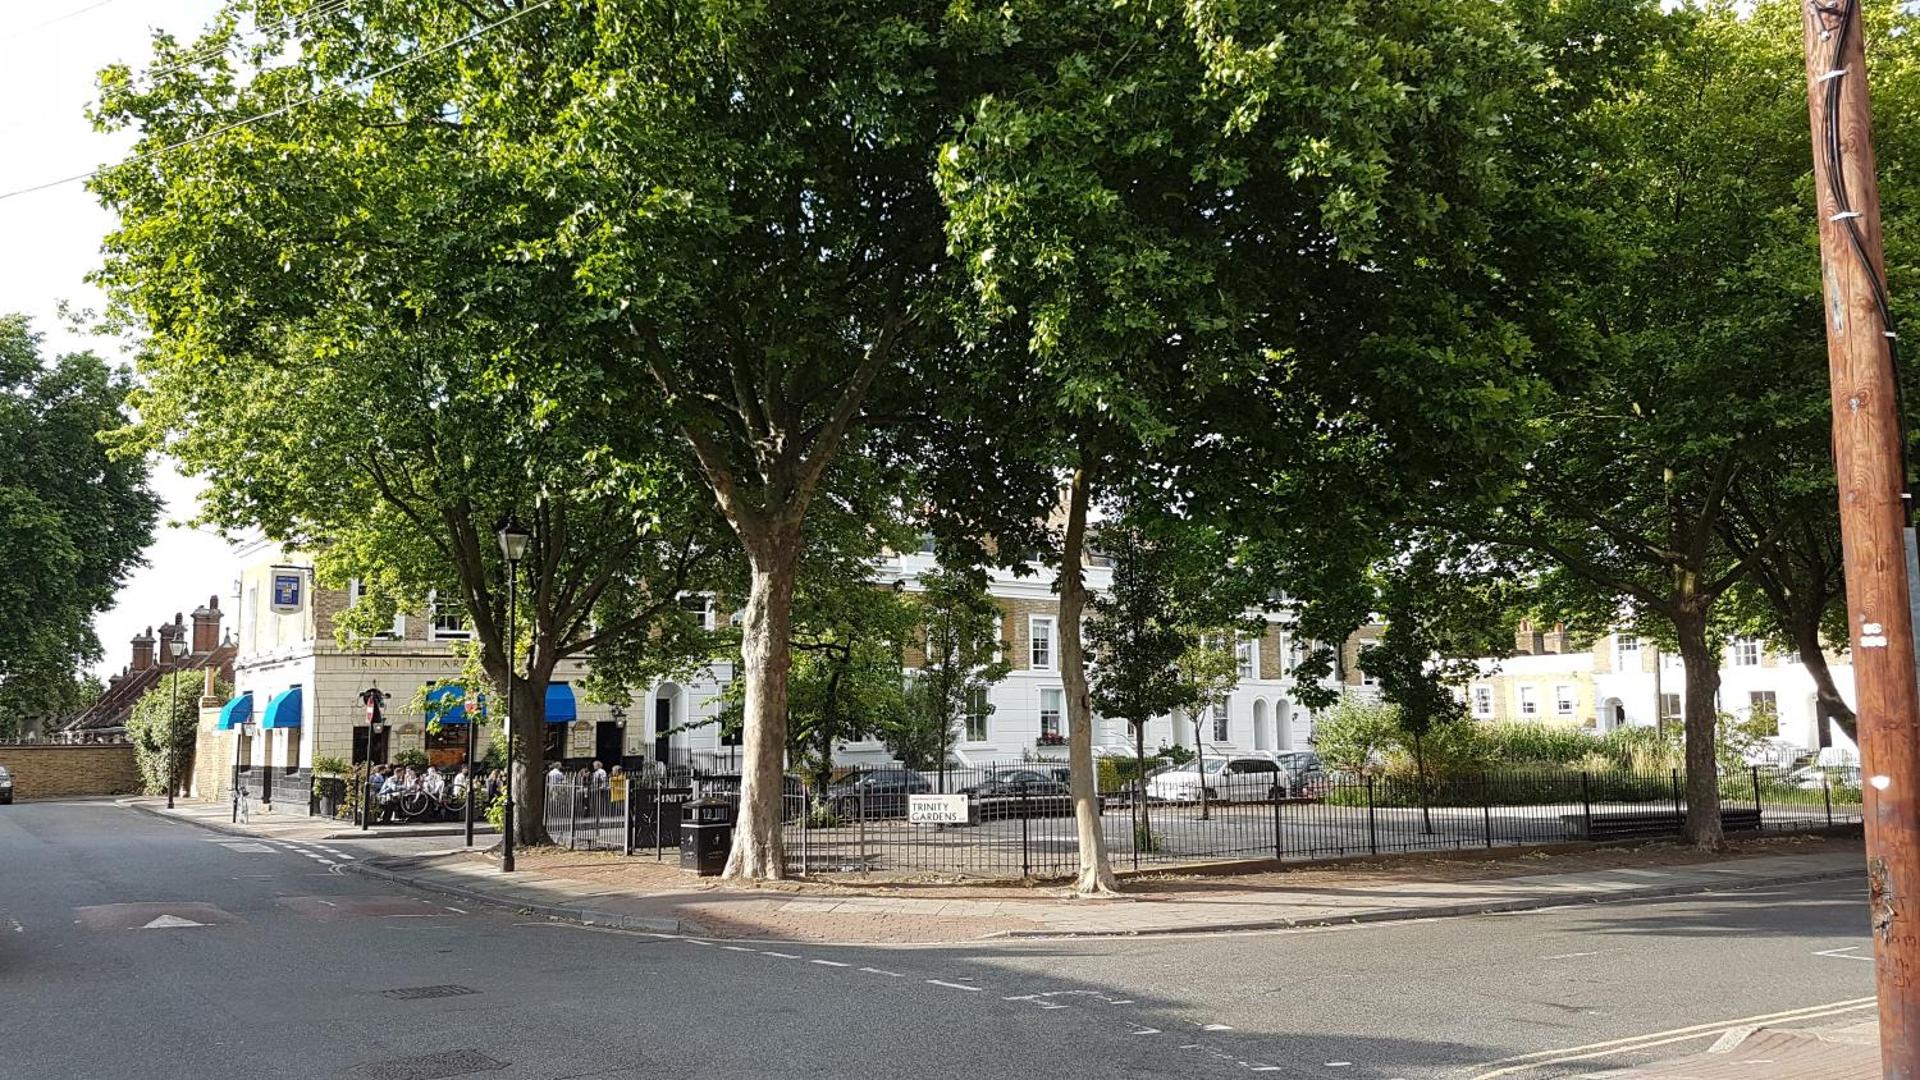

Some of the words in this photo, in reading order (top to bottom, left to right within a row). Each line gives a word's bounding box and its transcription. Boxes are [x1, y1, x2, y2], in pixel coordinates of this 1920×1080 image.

[351, 658, 427, 668] TRINITY
[441, 658, 463, 668] AR
[912, 803, 949, 811] TRINITY
[912, 812, 957, 821] GARDENS
